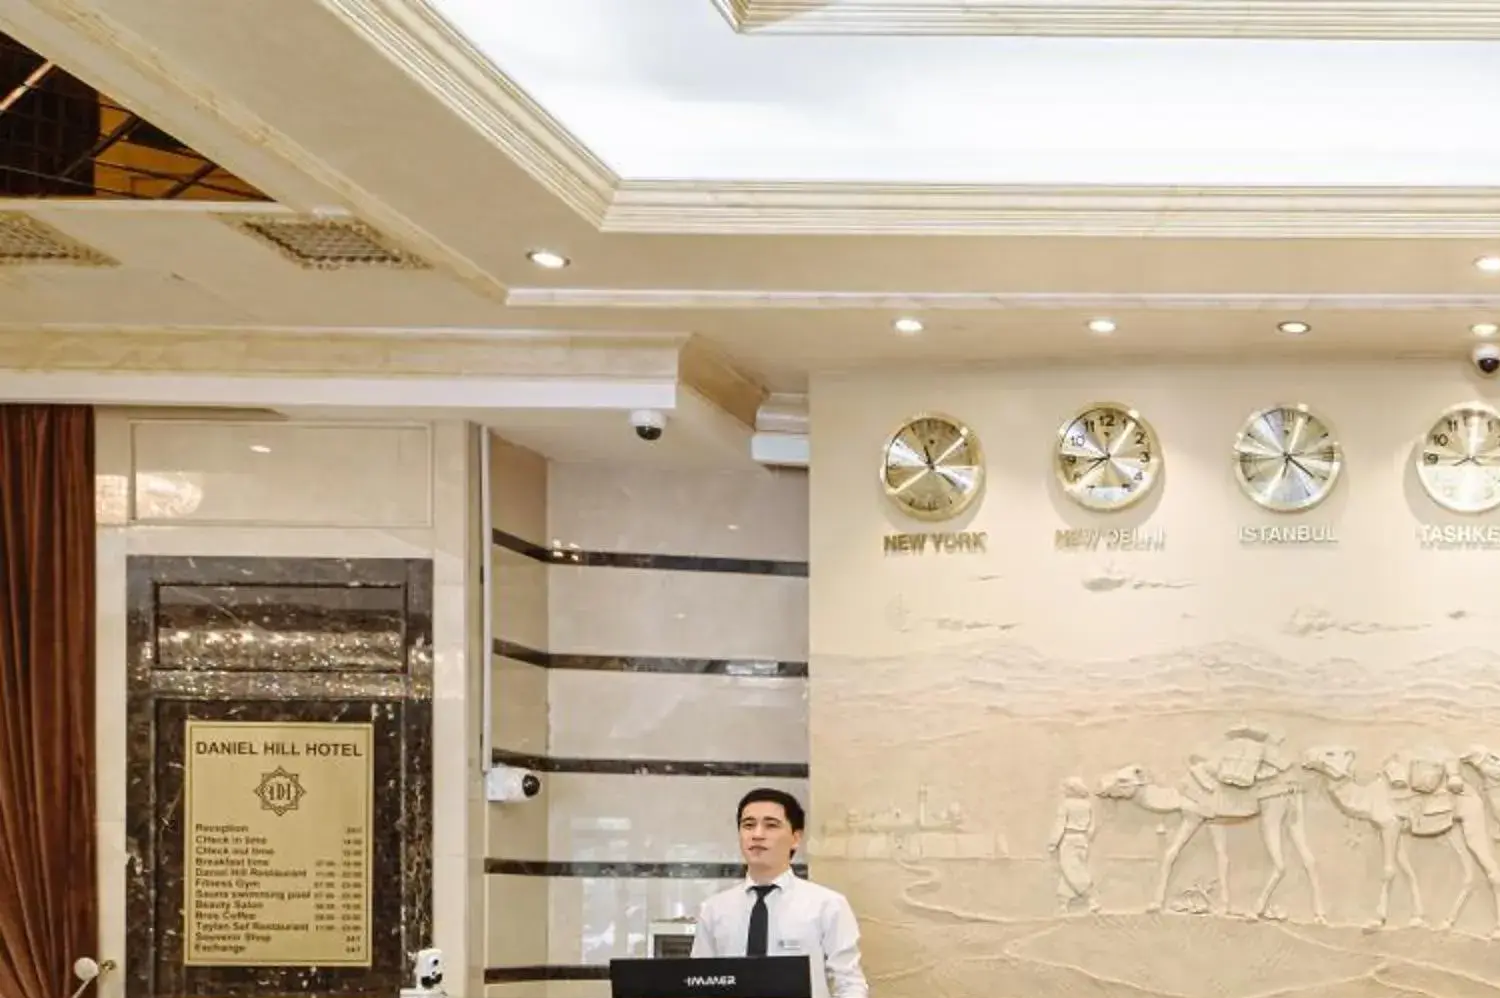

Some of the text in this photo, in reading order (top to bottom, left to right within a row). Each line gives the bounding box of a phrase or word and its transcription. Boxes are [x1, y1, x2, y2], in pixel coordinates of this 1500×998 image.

[884, 531, 988, 555] NEW YORK
[1055, 529, 1102, 549] NEW
[1239, 525, 1339, 544] ISTANBUL
[195, 741, 363, 757] DANIEL HILL HOTEL
